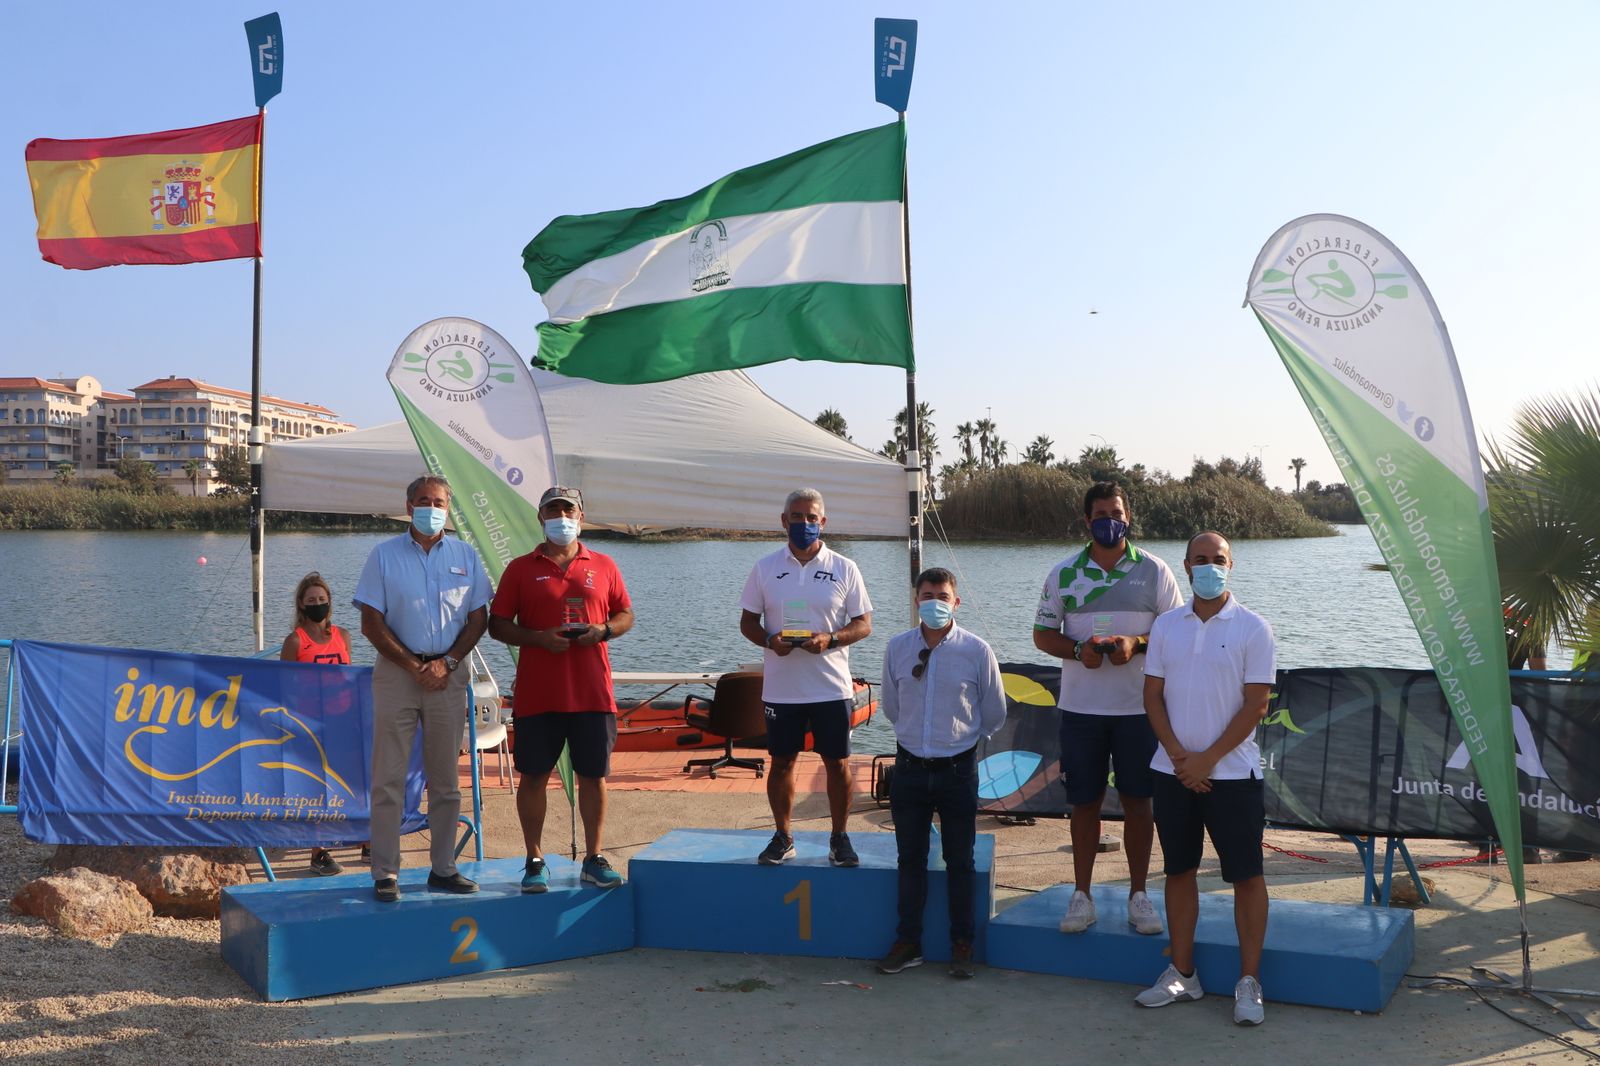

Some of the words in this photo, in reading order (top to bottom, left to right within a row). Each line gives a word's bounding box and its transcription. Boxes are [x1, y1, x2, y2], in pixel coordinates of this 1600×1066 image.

[114, 667, 243, 729] imd
[167, 790, 236, 805] Instituto
[242, 792, 323, 808] Municipal
[328, 795, 345, 808] de
[1392, 776, 1454, 796] Junta
[1461, 782, 1488, 802] de
[185, 807, 256, 824] Deportes
[261, 809, 278, 821] de
[283, 809, 300, 822] El
[305, 809, 347, 824] Ejido
[783, 880, 811, 940] 1
[449, 916, 478, 963] 2
